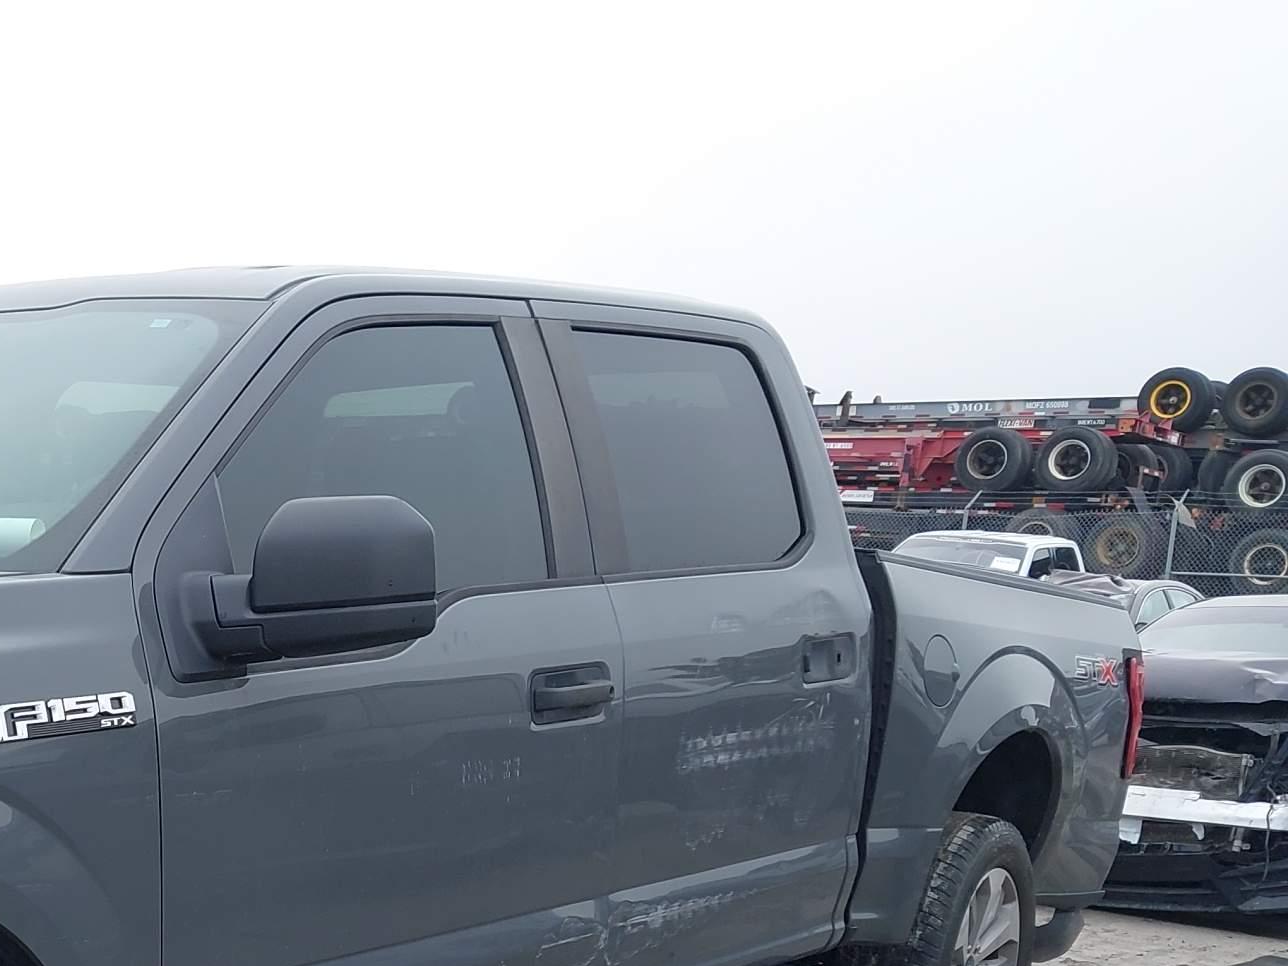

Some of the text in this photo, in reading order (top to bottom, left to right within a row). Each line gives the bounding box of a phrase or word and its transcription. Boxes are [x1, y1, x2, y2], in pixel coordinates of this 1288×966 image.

[962, 402, 993, 412] MOL
[1075, 655, 1119, 687] STX
[100, 715, 135, 728] STX
